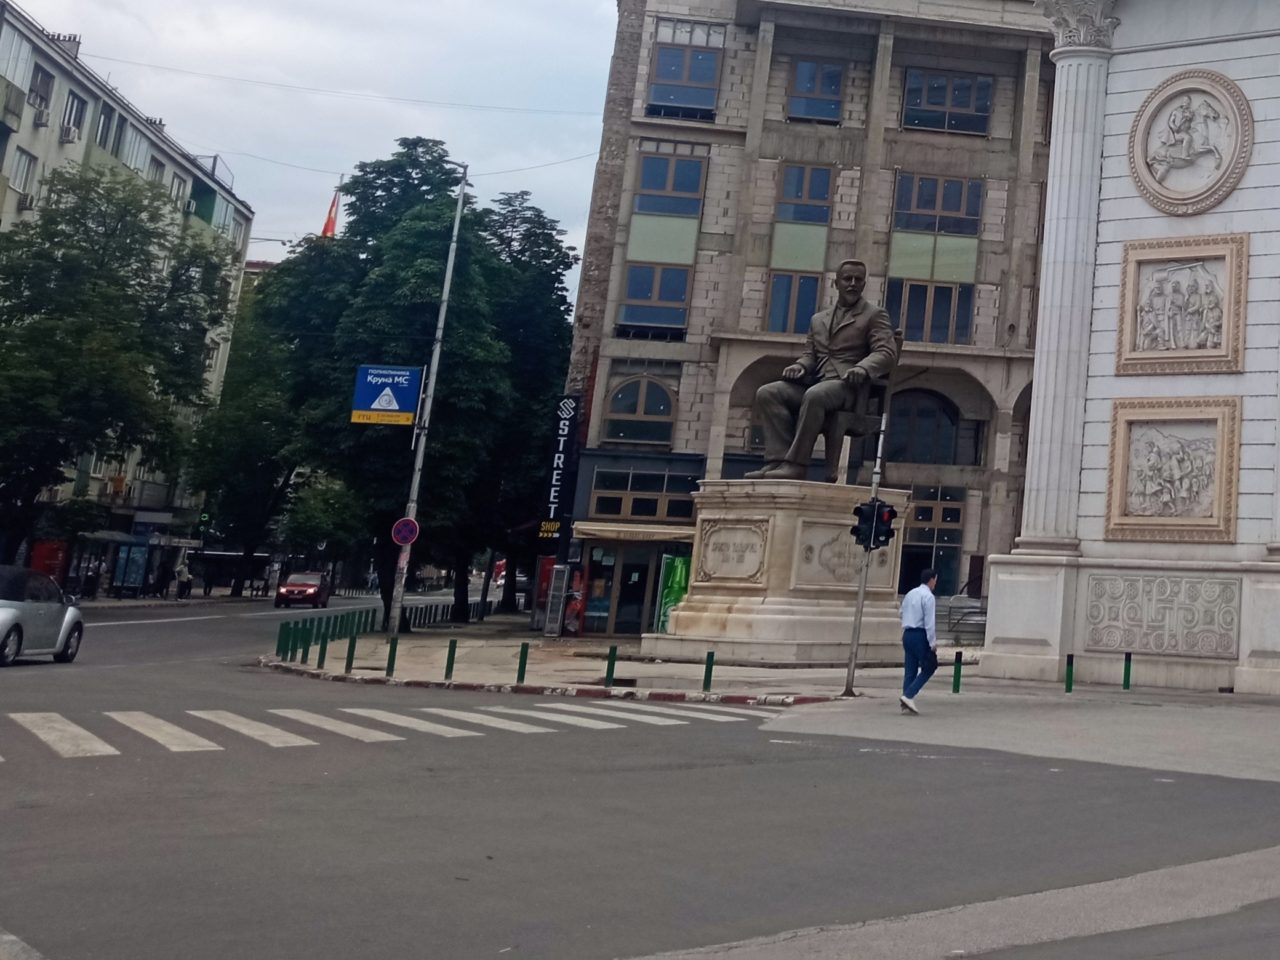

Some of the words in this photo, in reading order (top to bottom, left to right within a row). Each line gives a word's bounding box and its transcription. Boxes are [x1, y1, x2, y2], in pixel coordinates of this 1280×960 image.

[367, 375, 393, 385] Круна
[394, 376, 409, 384] МС
[548, 420, 569, 519] STREET
[541, 521, 561, 532] SHOP
